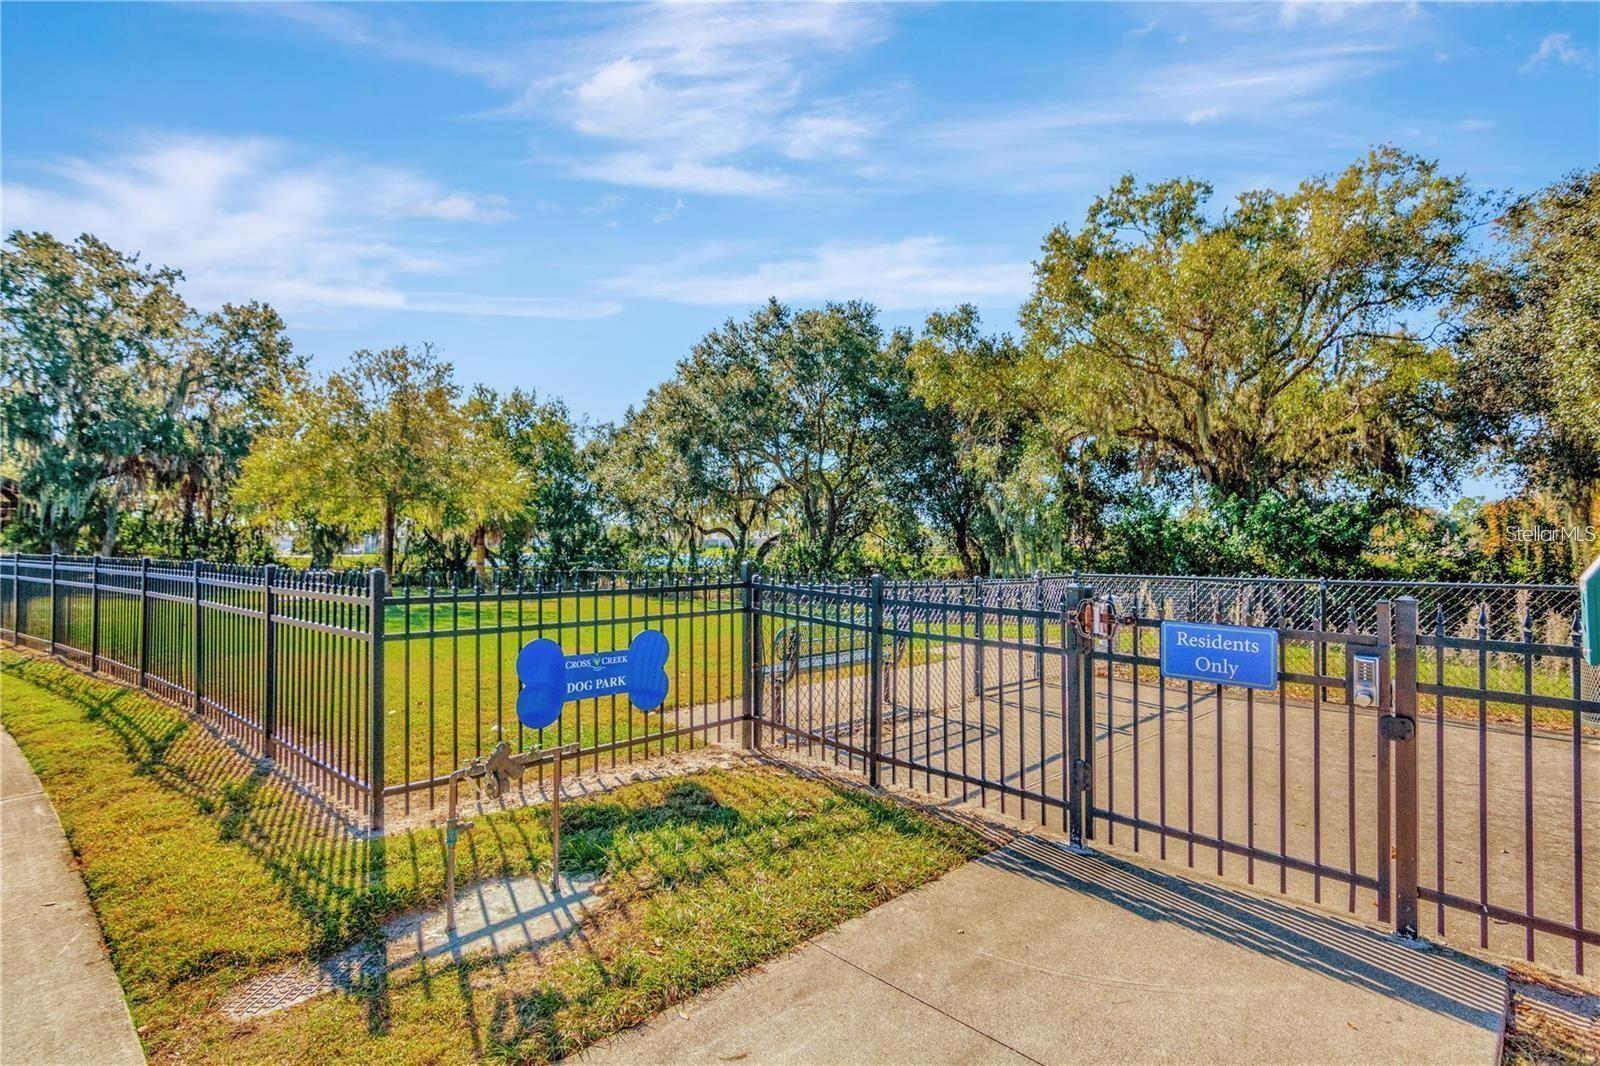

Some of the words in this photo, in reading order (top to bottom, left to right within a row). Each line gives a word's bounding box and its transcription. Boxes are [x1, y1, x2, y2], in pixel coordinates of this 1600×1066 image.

[1176, 631, 1260, 653] Residents
[565, 659, 591, 670] CROSS
[601, 656, 628, 665] CREEK
[1195, 656, 1239, 679] Only
[567, 680, 593, 694] DOG
[596, 676, 626, 689] PARK
